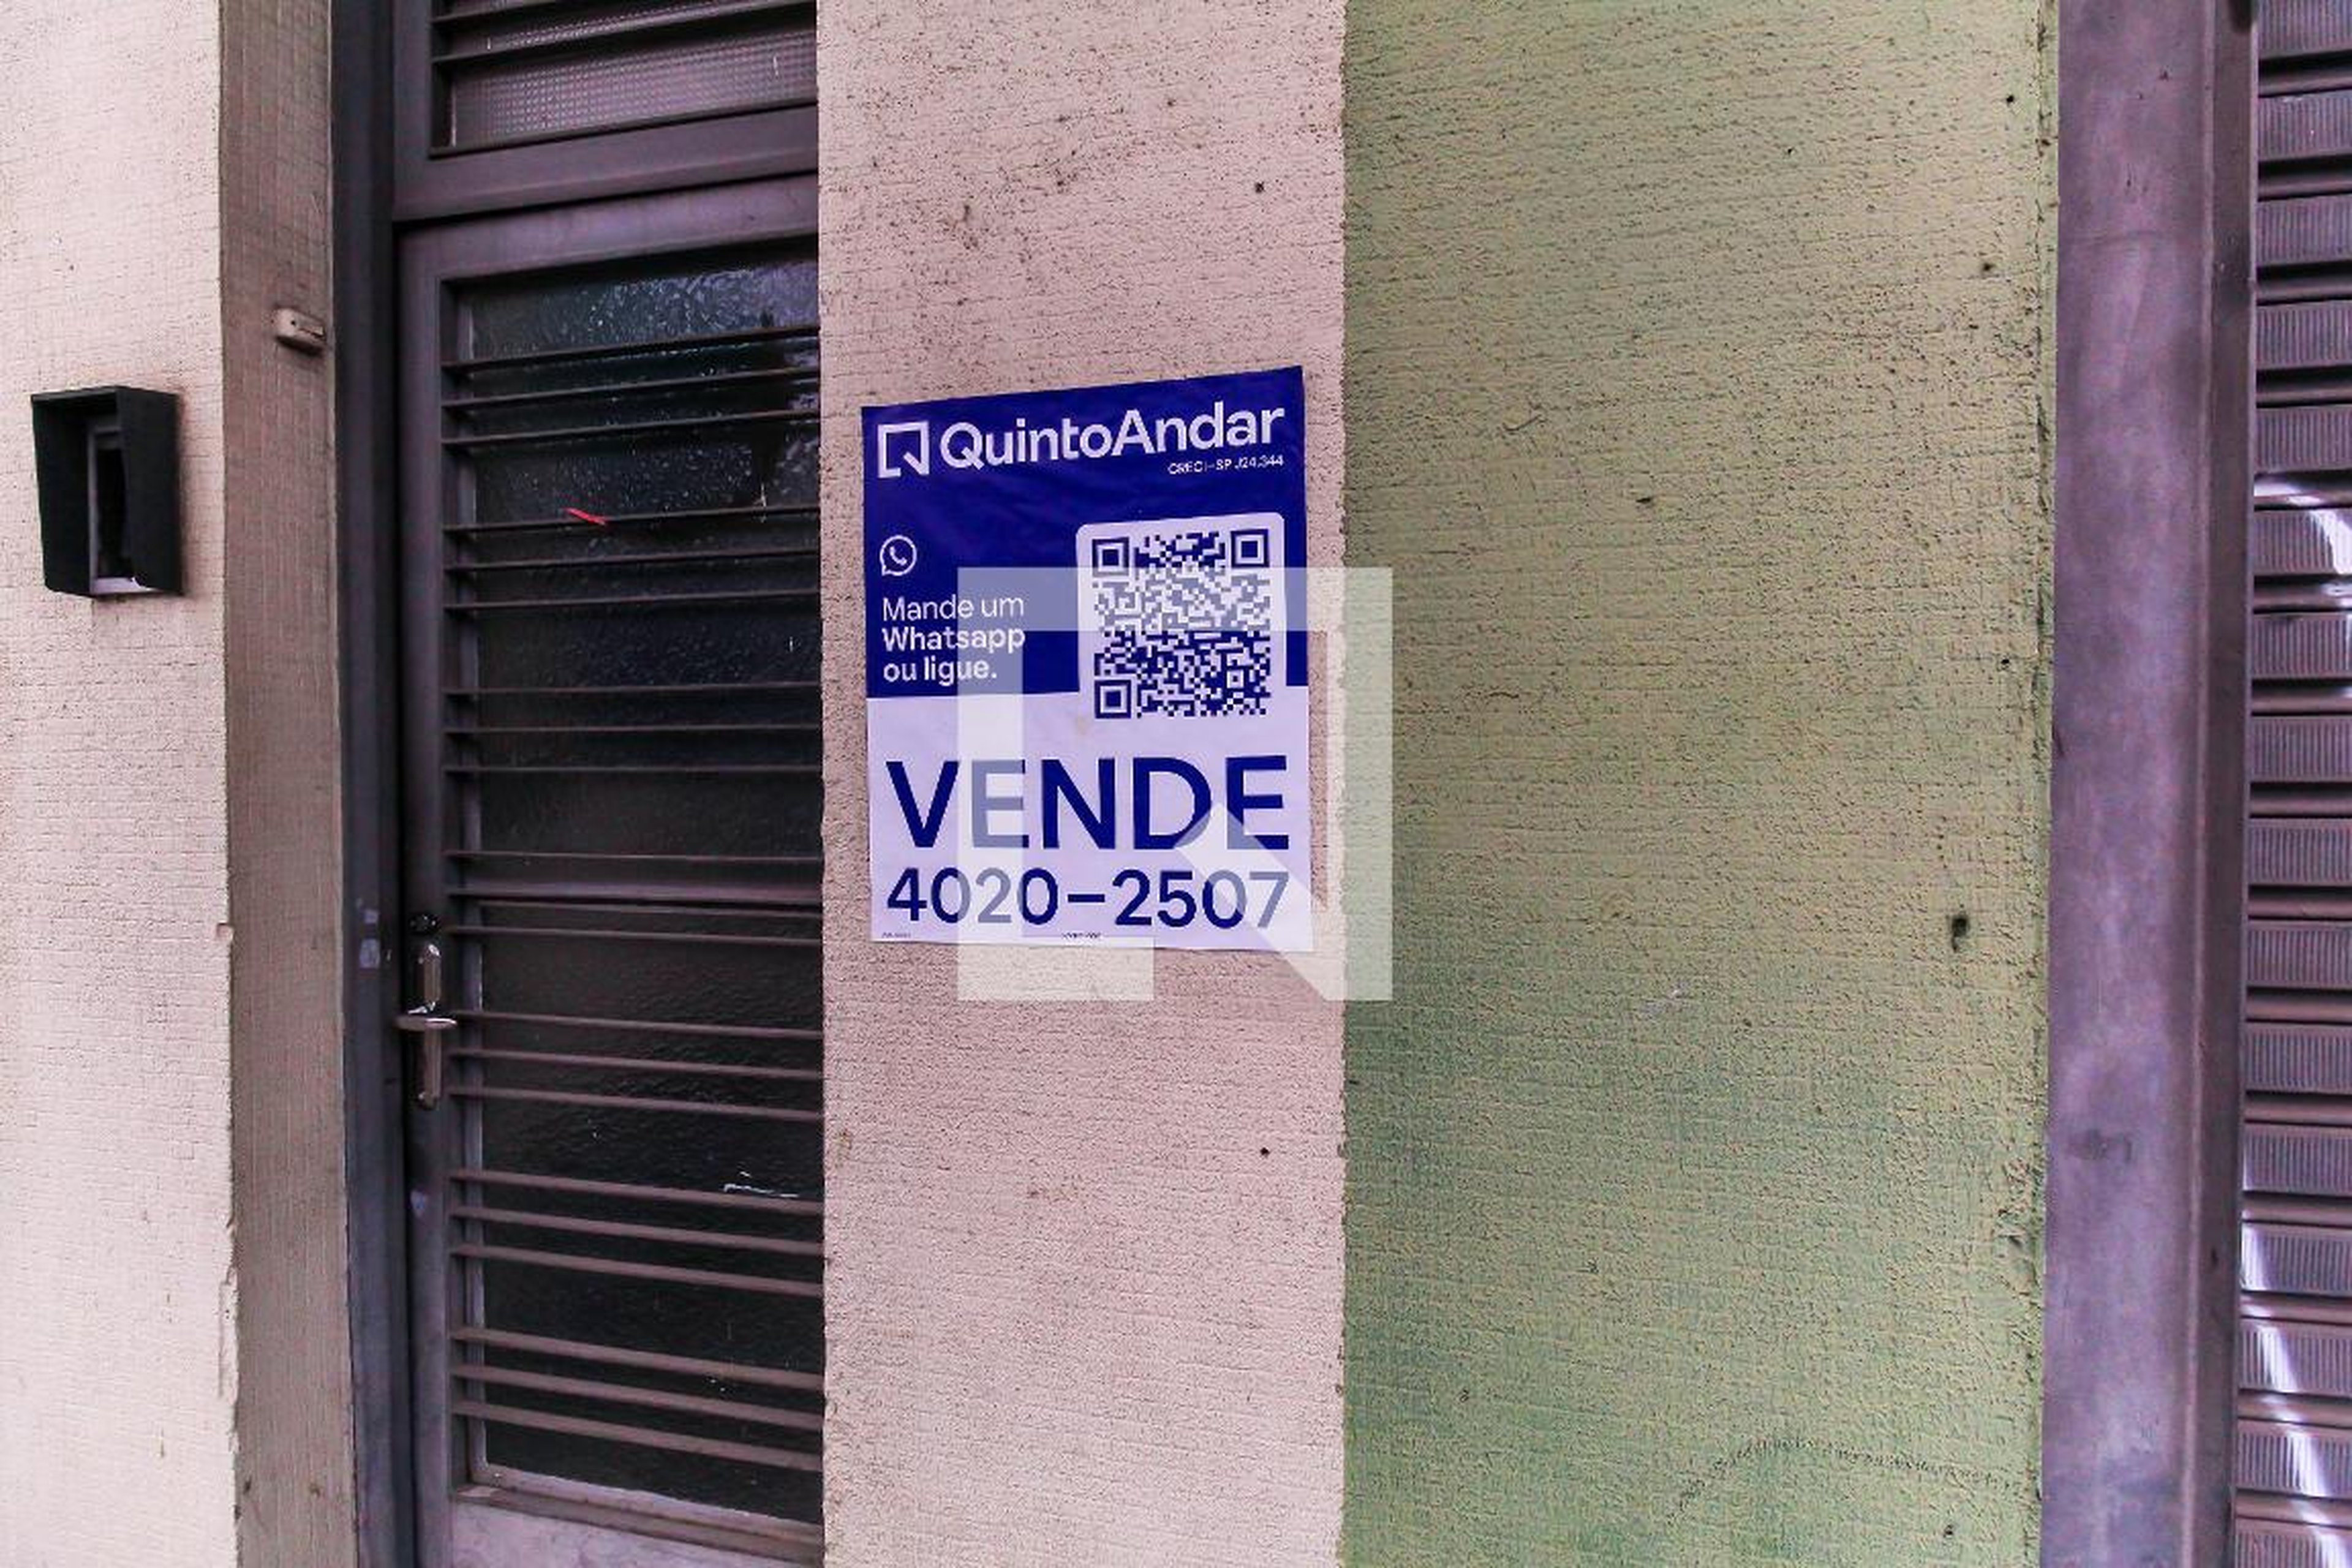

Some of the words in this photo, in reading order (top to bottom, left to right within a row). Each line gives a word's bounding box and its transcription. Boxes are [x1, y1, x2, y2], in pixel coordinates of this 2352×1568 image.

[940, 401, 1285, 471] QuintoAndar
[882, 594, 975, 621] Mande
[982, 597, 1025, 618] um
[882, 627, 1027, 655] Whatsapp
[883, 663, 918, 683] ou
[924, 655, 998, 687] ligue.
[886, 755, 1290, 851] VENDE
[887, 867, 1289, 929] 4020-2507
